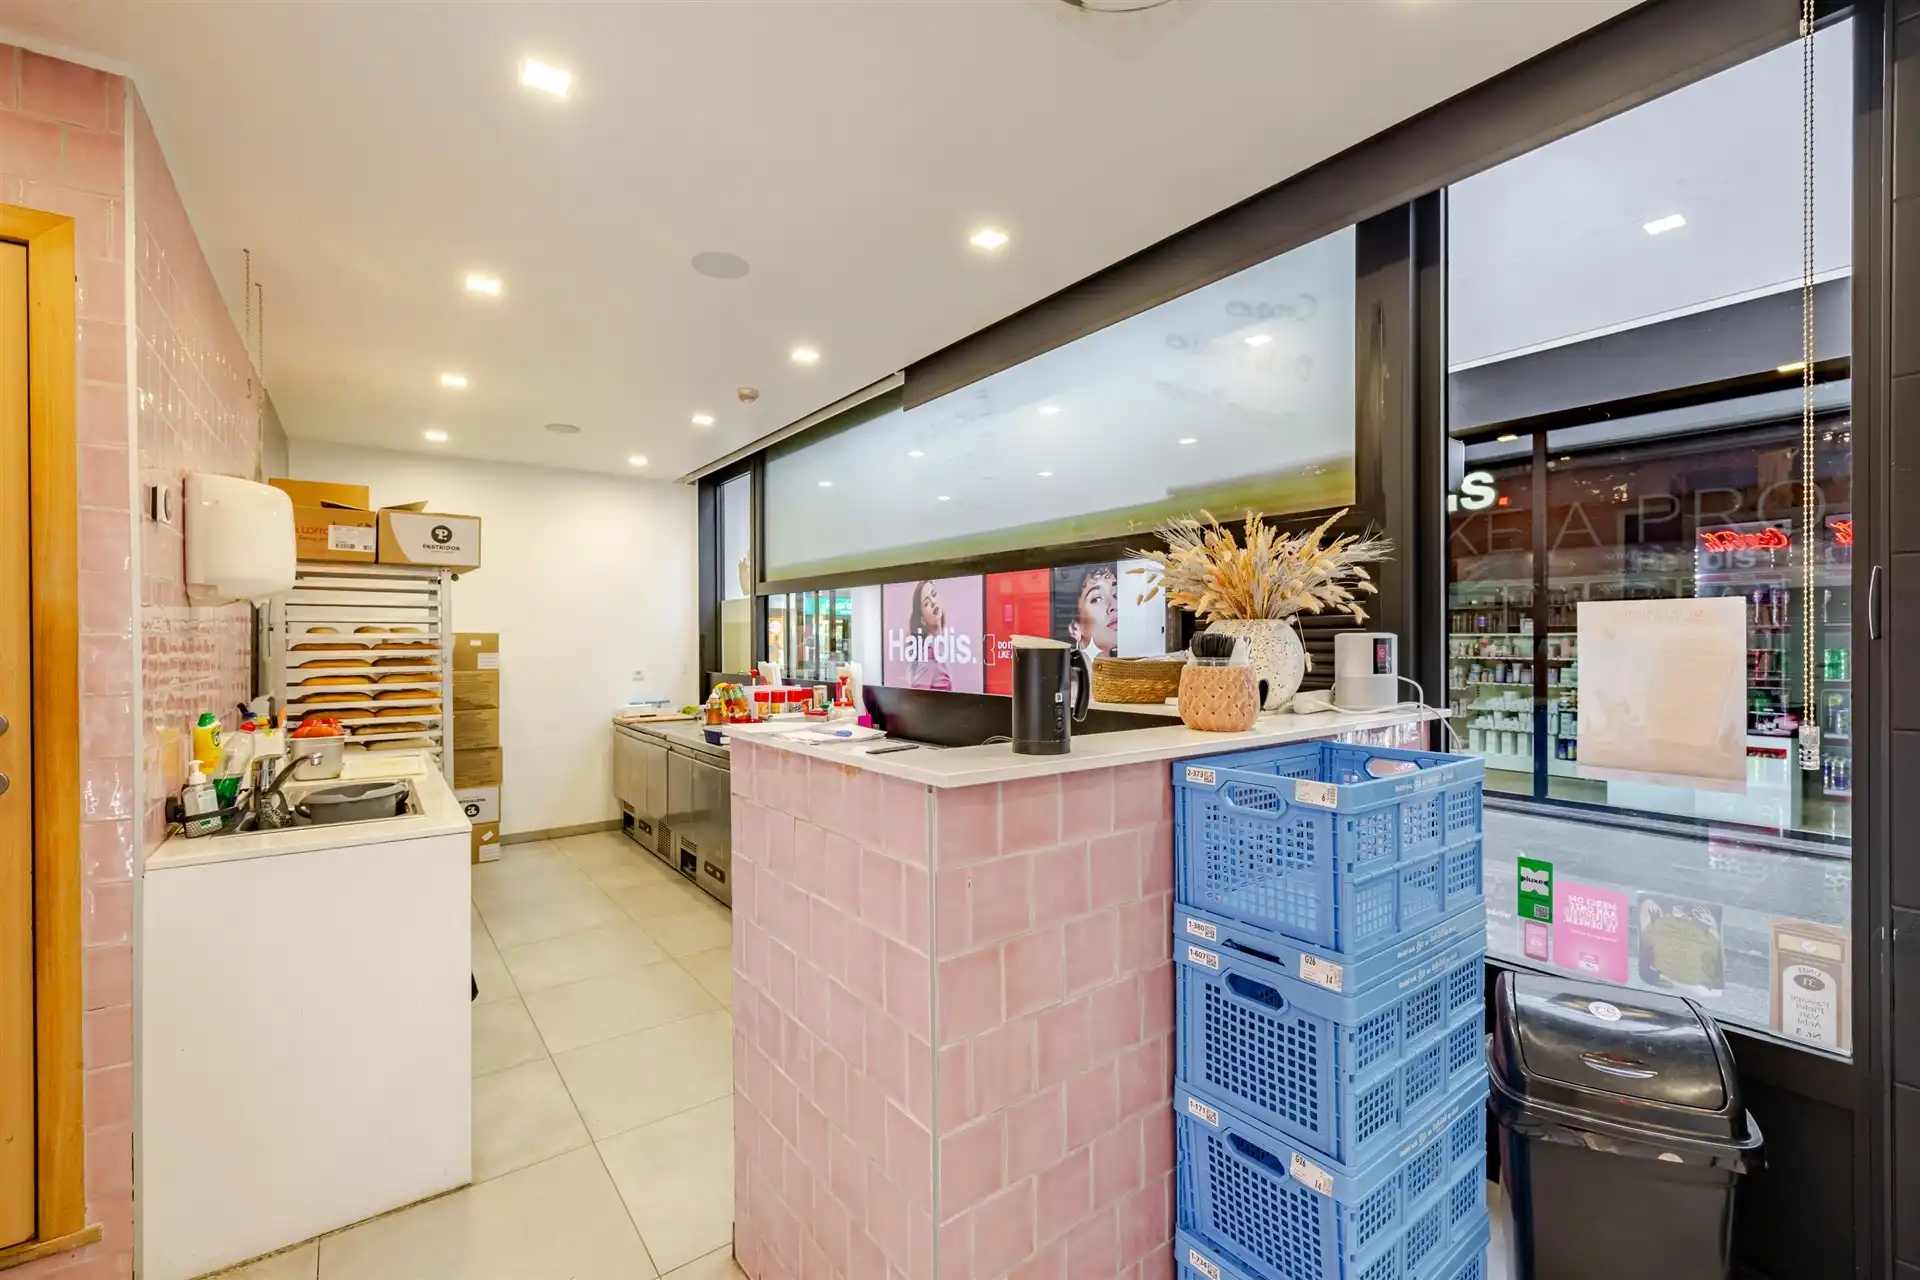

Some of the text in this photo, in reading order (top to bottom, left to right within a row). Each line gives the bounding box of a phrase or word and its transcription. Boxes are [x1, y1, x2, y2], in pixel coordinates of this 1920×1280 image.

[422, 543, 461, 551] PASTRIDOR
[888, 627, 977, 664] Hairdis.
[997, 640, 1007, 650] DO
[1187, 769, 1204, 778] 2-373
